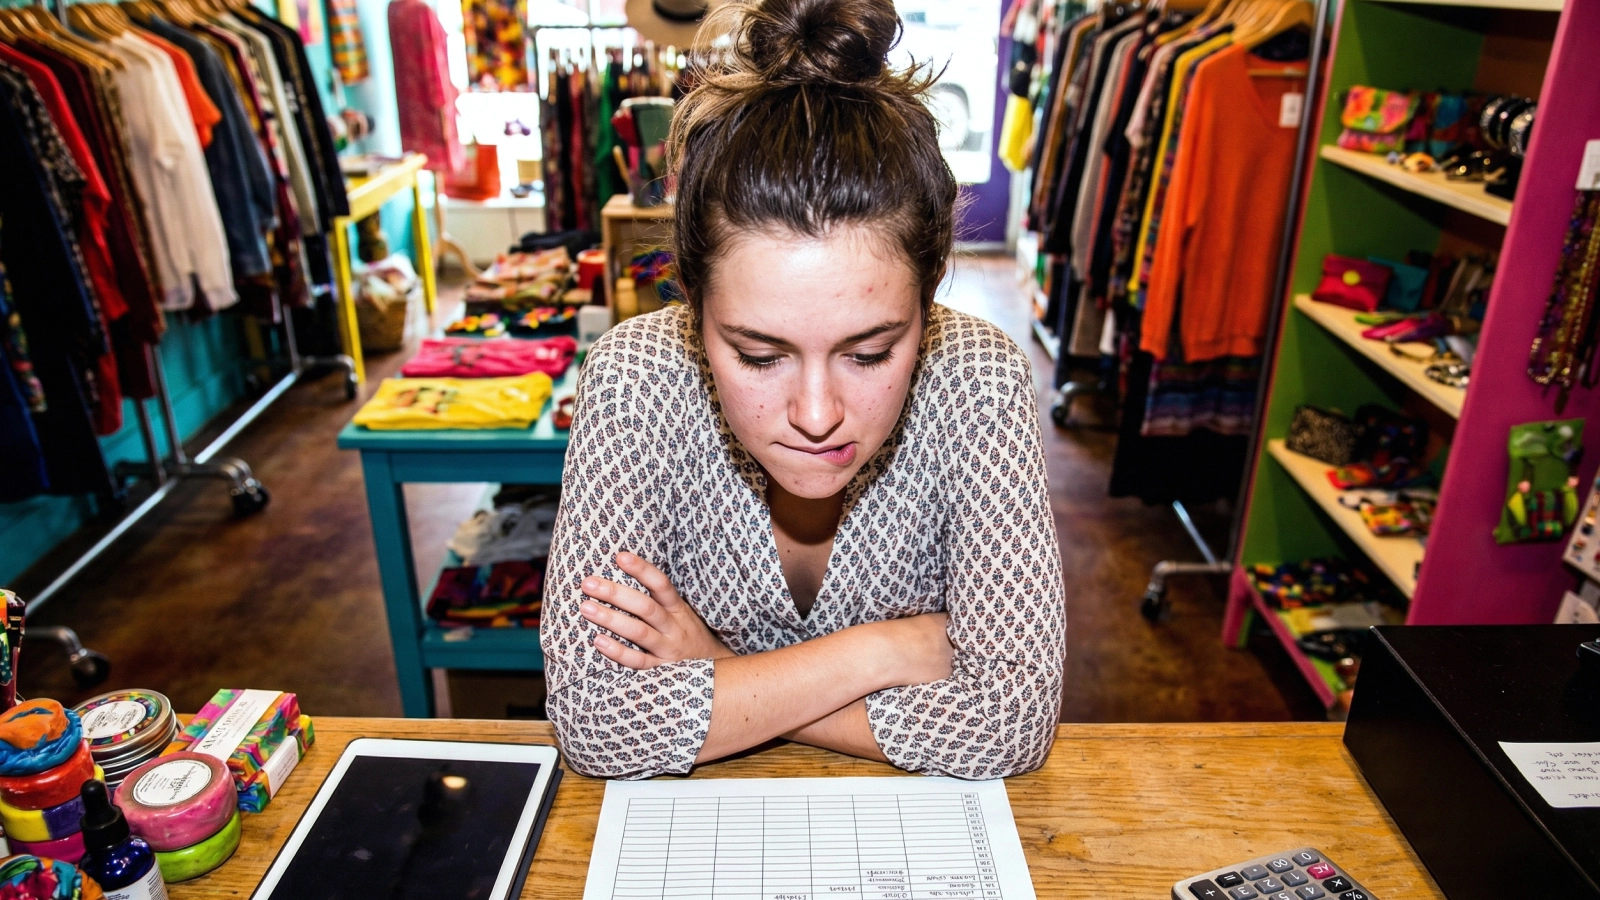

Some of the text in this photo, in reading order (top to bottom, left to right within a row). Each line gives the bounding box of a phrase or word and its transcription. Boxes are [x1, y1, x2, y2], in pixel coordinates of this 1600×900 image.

[1301, 852, 1312, 860] 0
[1290, 872, 1300, 880] 1
[1263, 879, 1276, 888] 2
[1237, 886, 1250, 895] 3
[1305, 886, 1315, 895] 4
